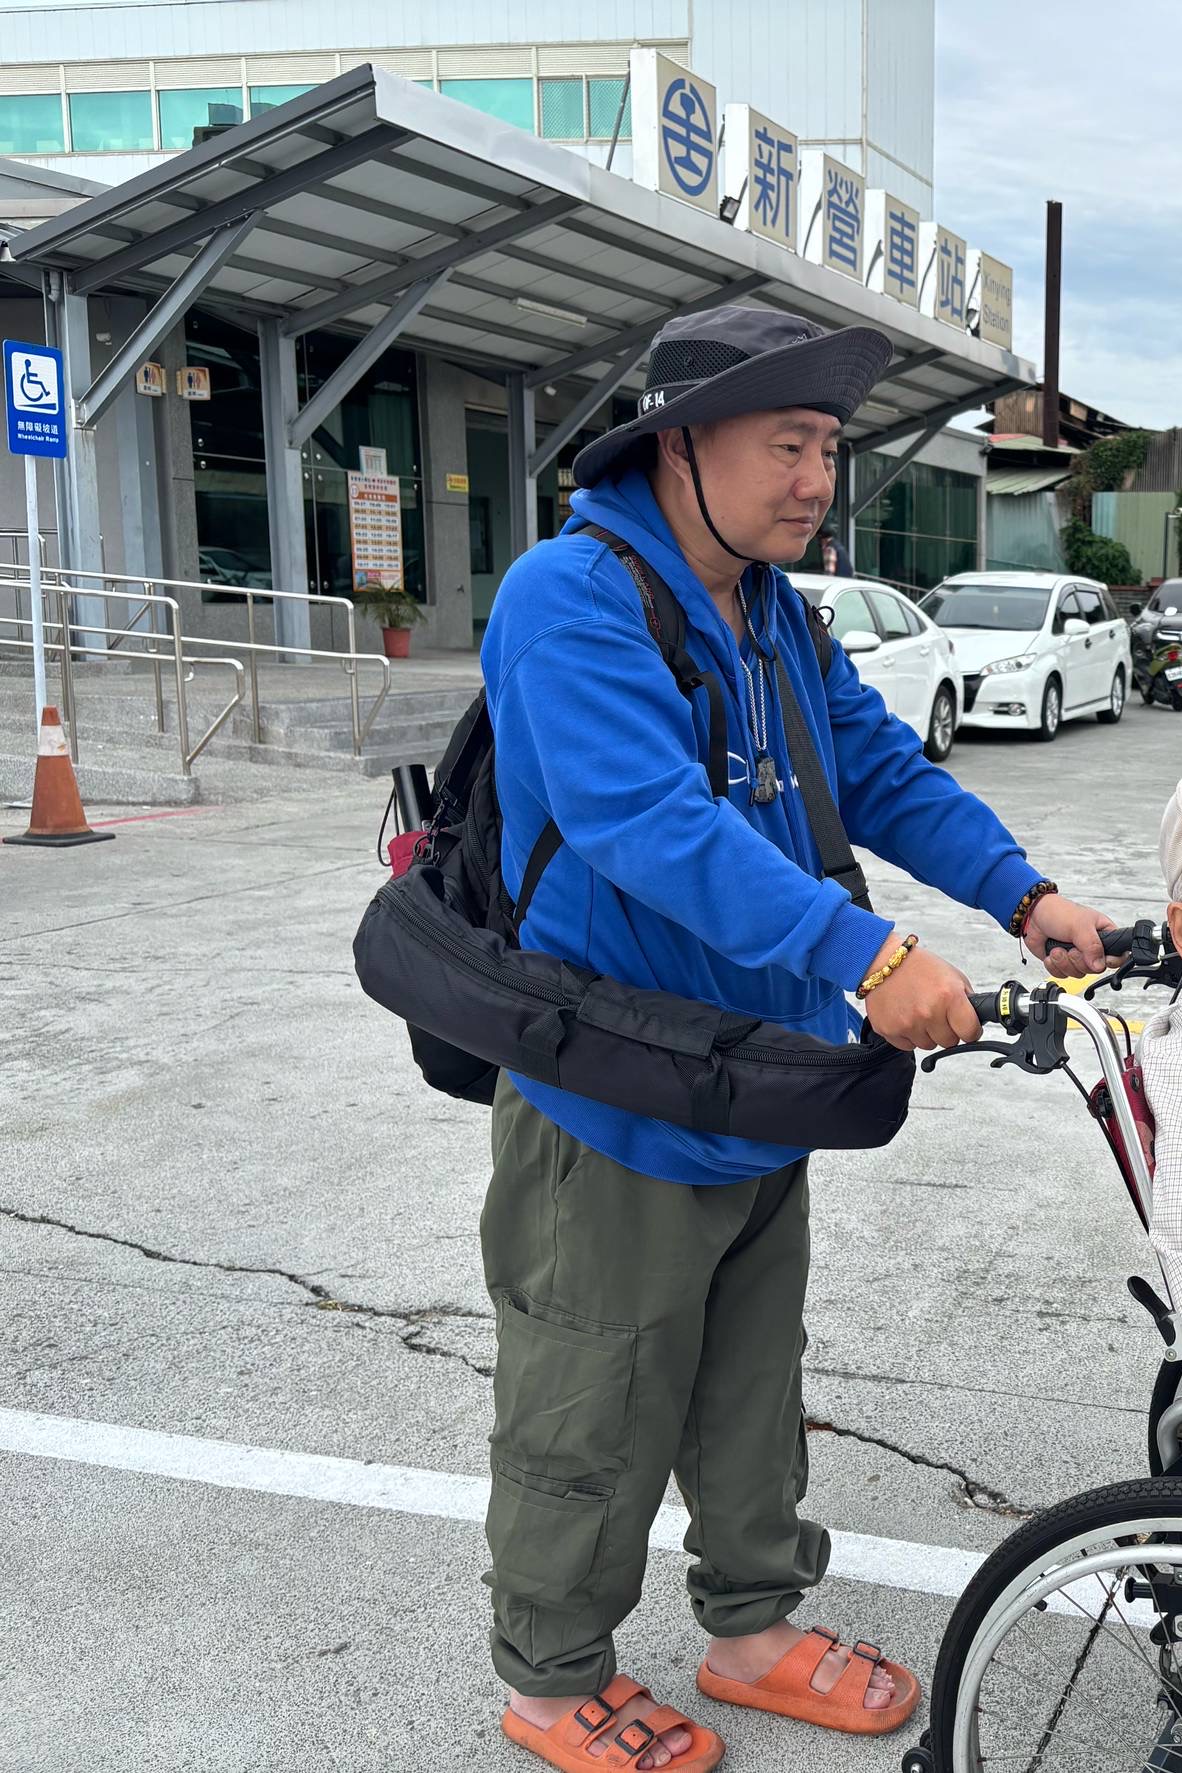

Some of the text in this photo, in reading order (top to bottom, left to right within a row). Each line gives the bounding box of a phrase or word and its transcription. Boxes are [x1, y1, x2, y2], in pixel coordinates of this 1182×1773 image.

[753, 126, 967, 322] 新營車站
[17, 420, 59, 435] 無障礙坡道
